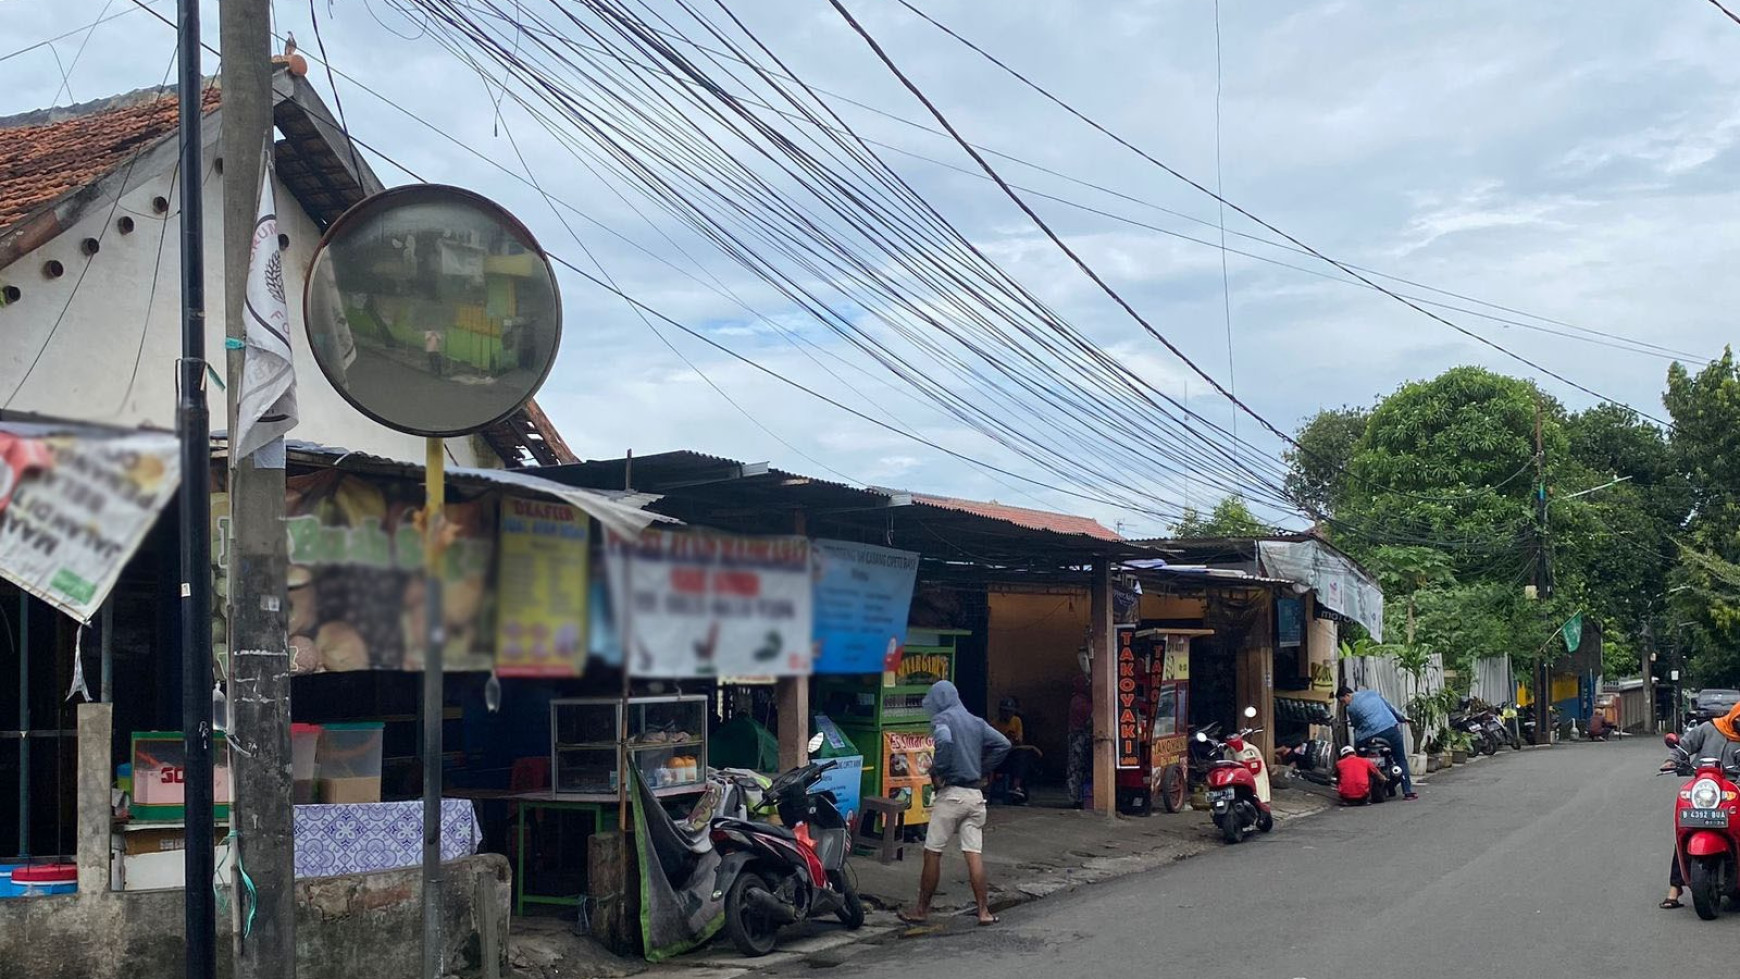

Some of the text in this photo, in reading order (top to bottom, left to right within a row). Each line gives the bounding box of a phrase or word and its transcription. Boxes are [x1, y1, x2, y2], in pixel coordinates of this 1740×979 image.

[1119, 631, 1136, 754] TAKOYAKI
[160, 767, 185, 784] SO
[1683, 810, 1688, 819] B
